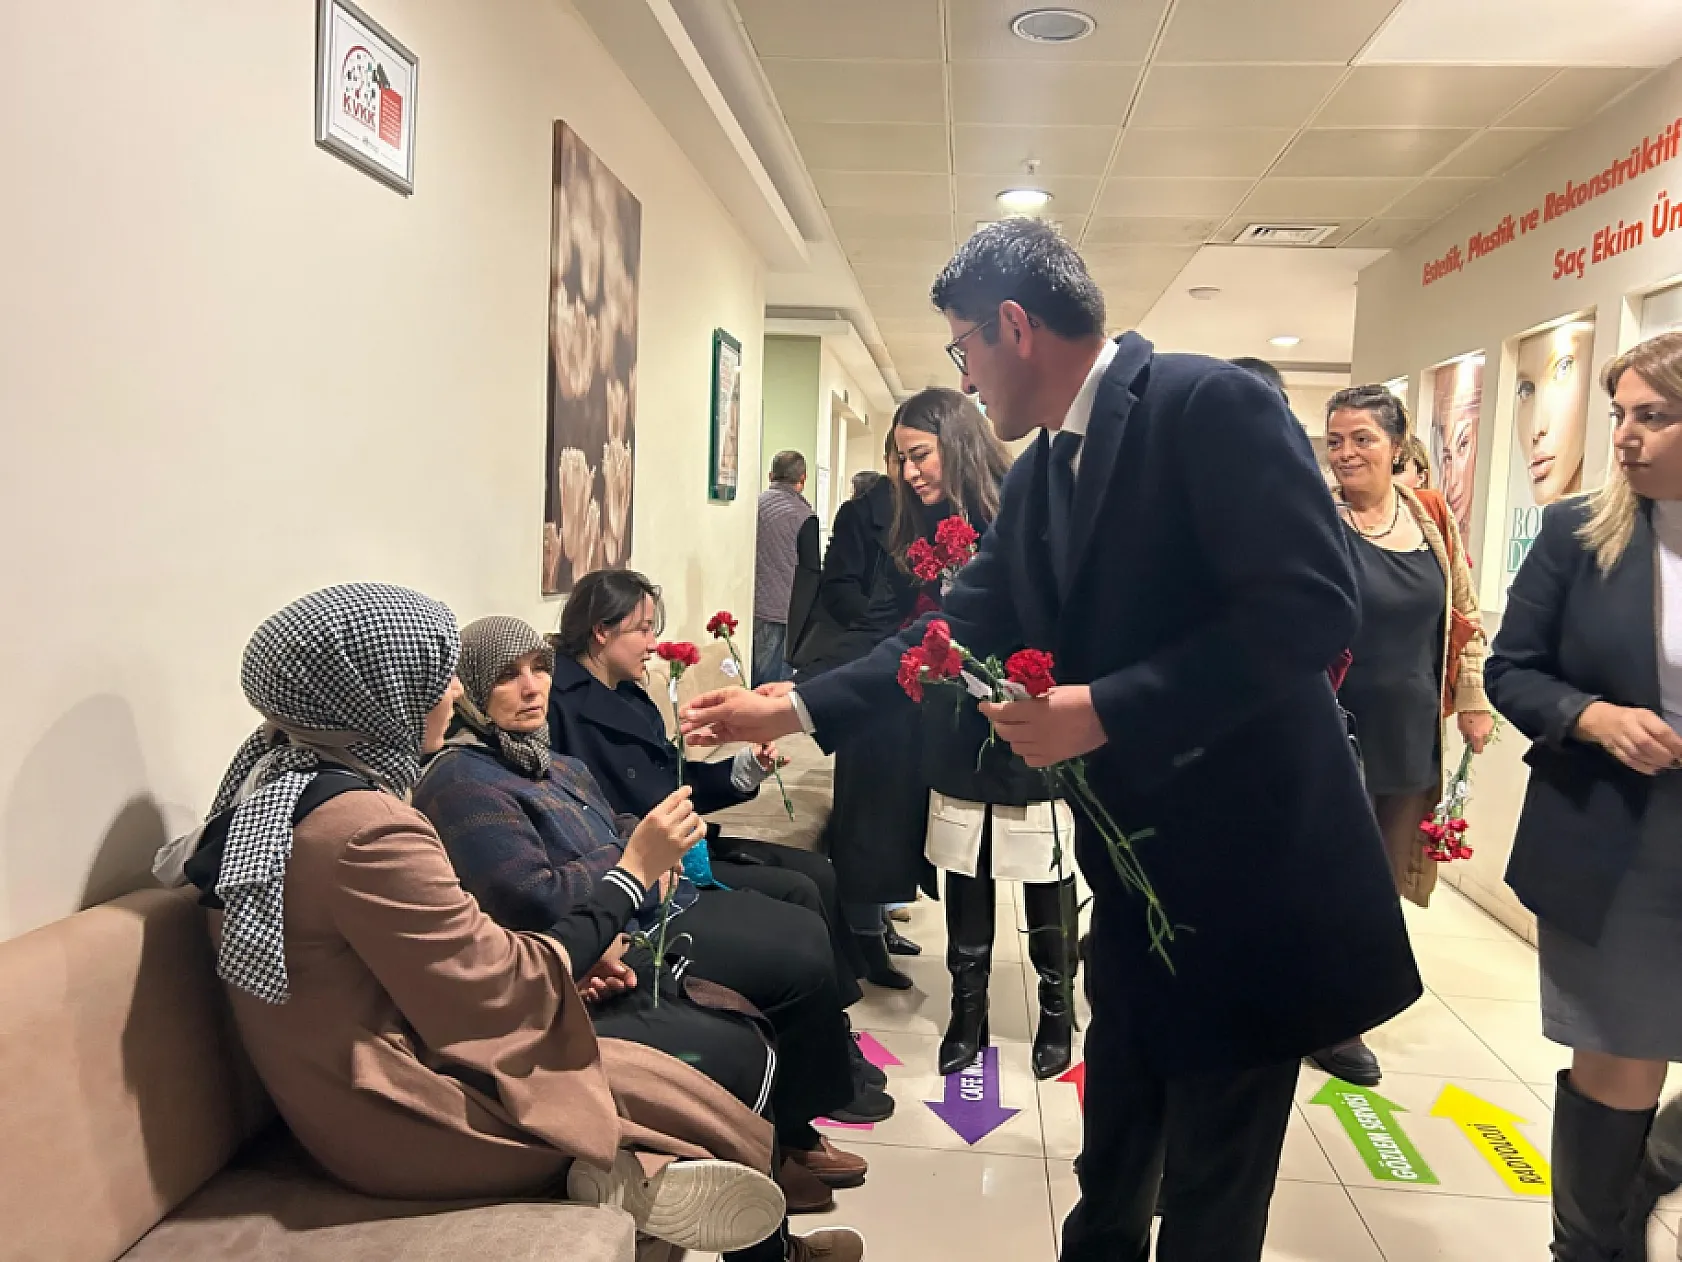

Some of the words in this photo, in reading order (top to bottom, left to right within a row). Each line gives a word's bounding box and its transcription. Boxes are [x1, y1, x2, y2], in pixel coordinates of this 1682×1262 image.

[1422, 245, 1464, 287] Estetik,
[1467, 214, 1516, 263] Plastik
[1520, 208, 1540, 235] ve
[1544, 118, 1682, 223] Rekonstrüktif
[1553, 248, 1587, 280] Saç
[1592, 220, 1644, 265] Ekim
[960, 1077, 984, 1101] CAFE
